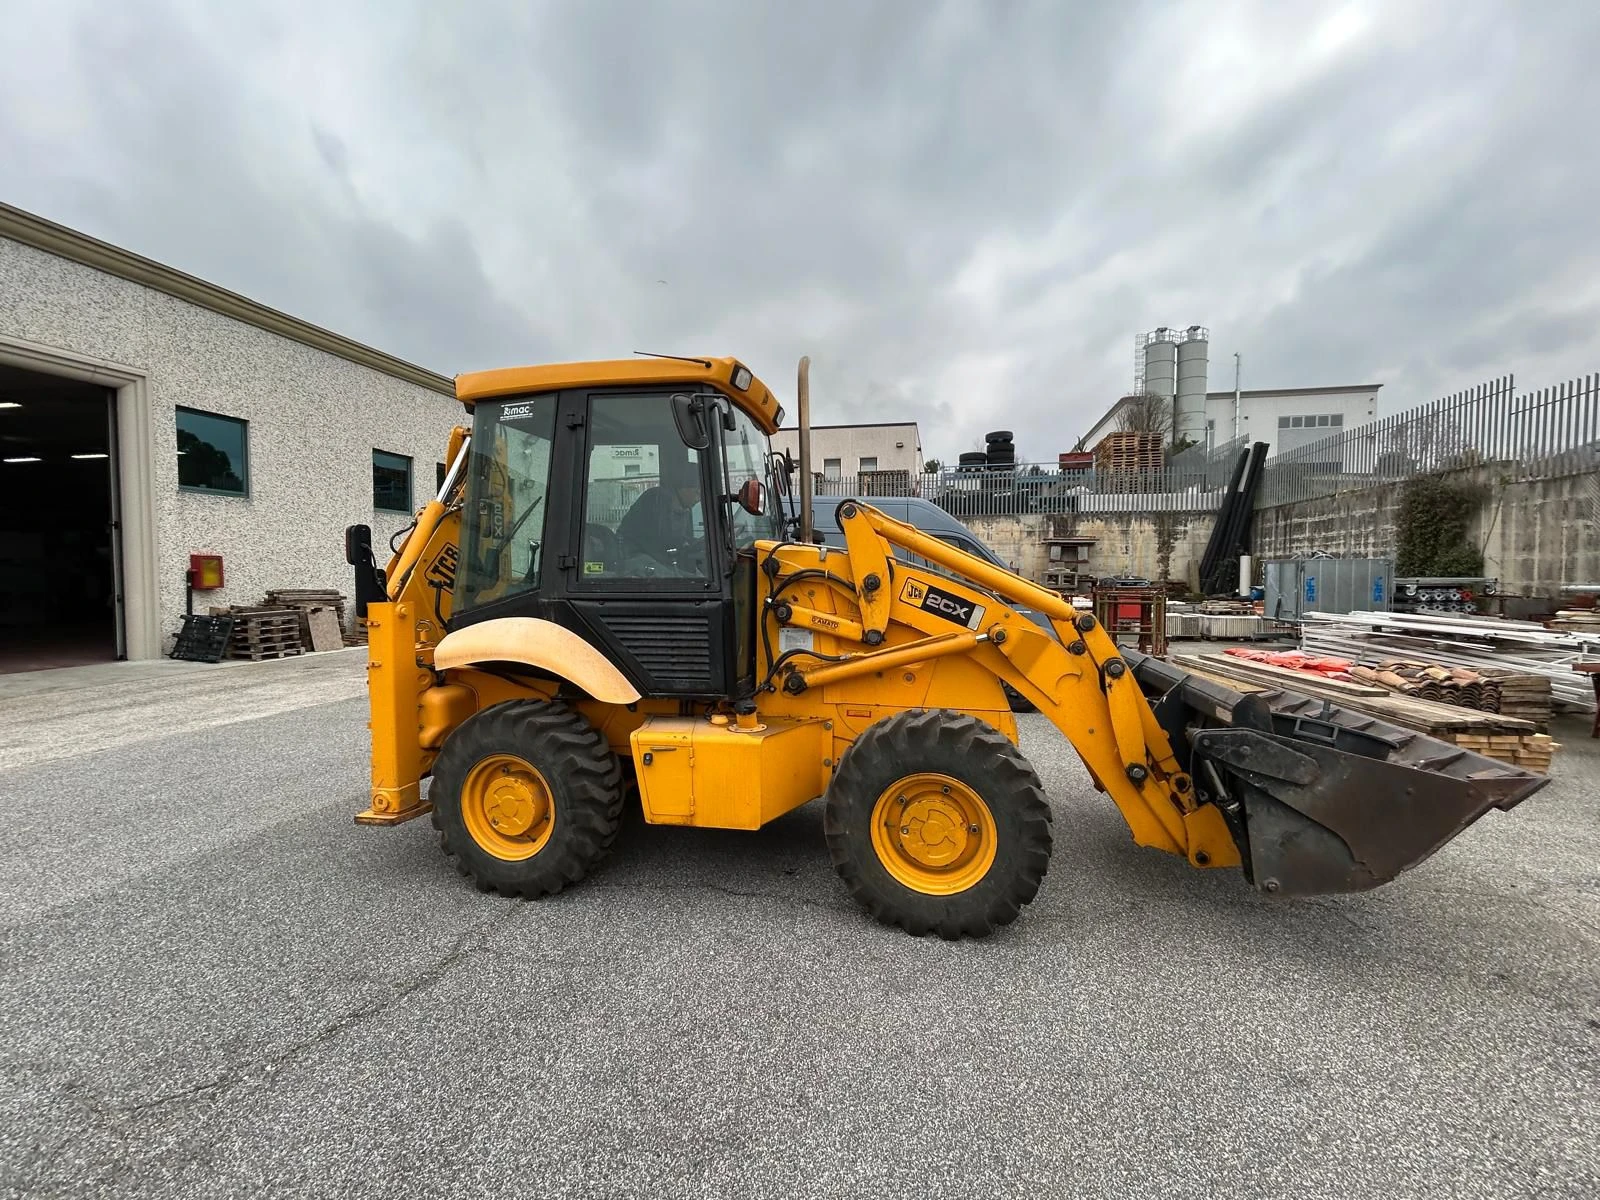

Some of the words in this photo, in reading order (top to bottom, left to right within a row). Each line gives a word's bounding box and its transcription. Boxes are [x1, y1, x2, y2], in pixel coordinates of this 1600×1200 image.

[429, 546, 458, 590] JCB
[907, 583, 923, 599] JCB
[925, 593, 969, 620] 2CX
